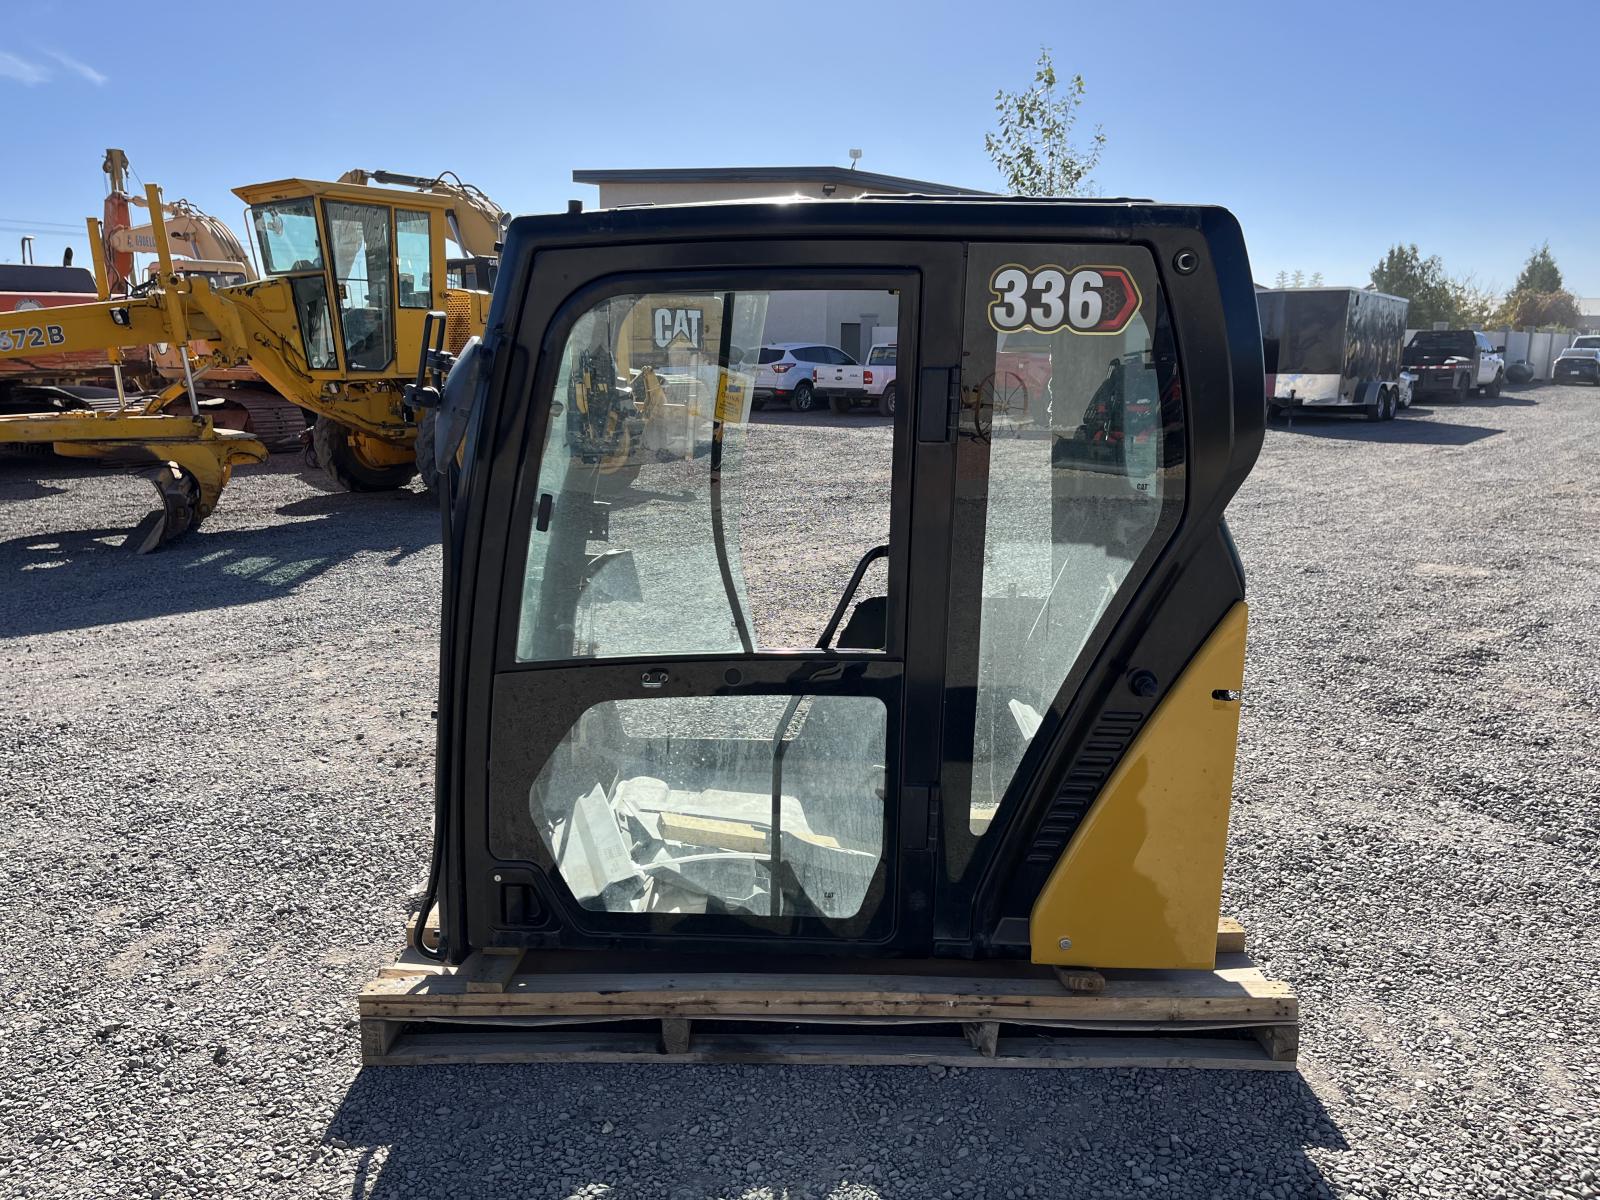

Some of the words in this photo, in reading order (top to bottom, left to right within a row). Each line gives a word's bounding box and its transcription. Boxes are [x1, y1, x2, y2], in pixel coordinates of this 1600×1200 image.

[993, 269, 1104, 329] 336
[0, 325, 66, 351] 672B
[655, 308, 701, 348] CAT
[1136, 483, 1149, 491] CAT
[824, 891, 835, 899] CAT
